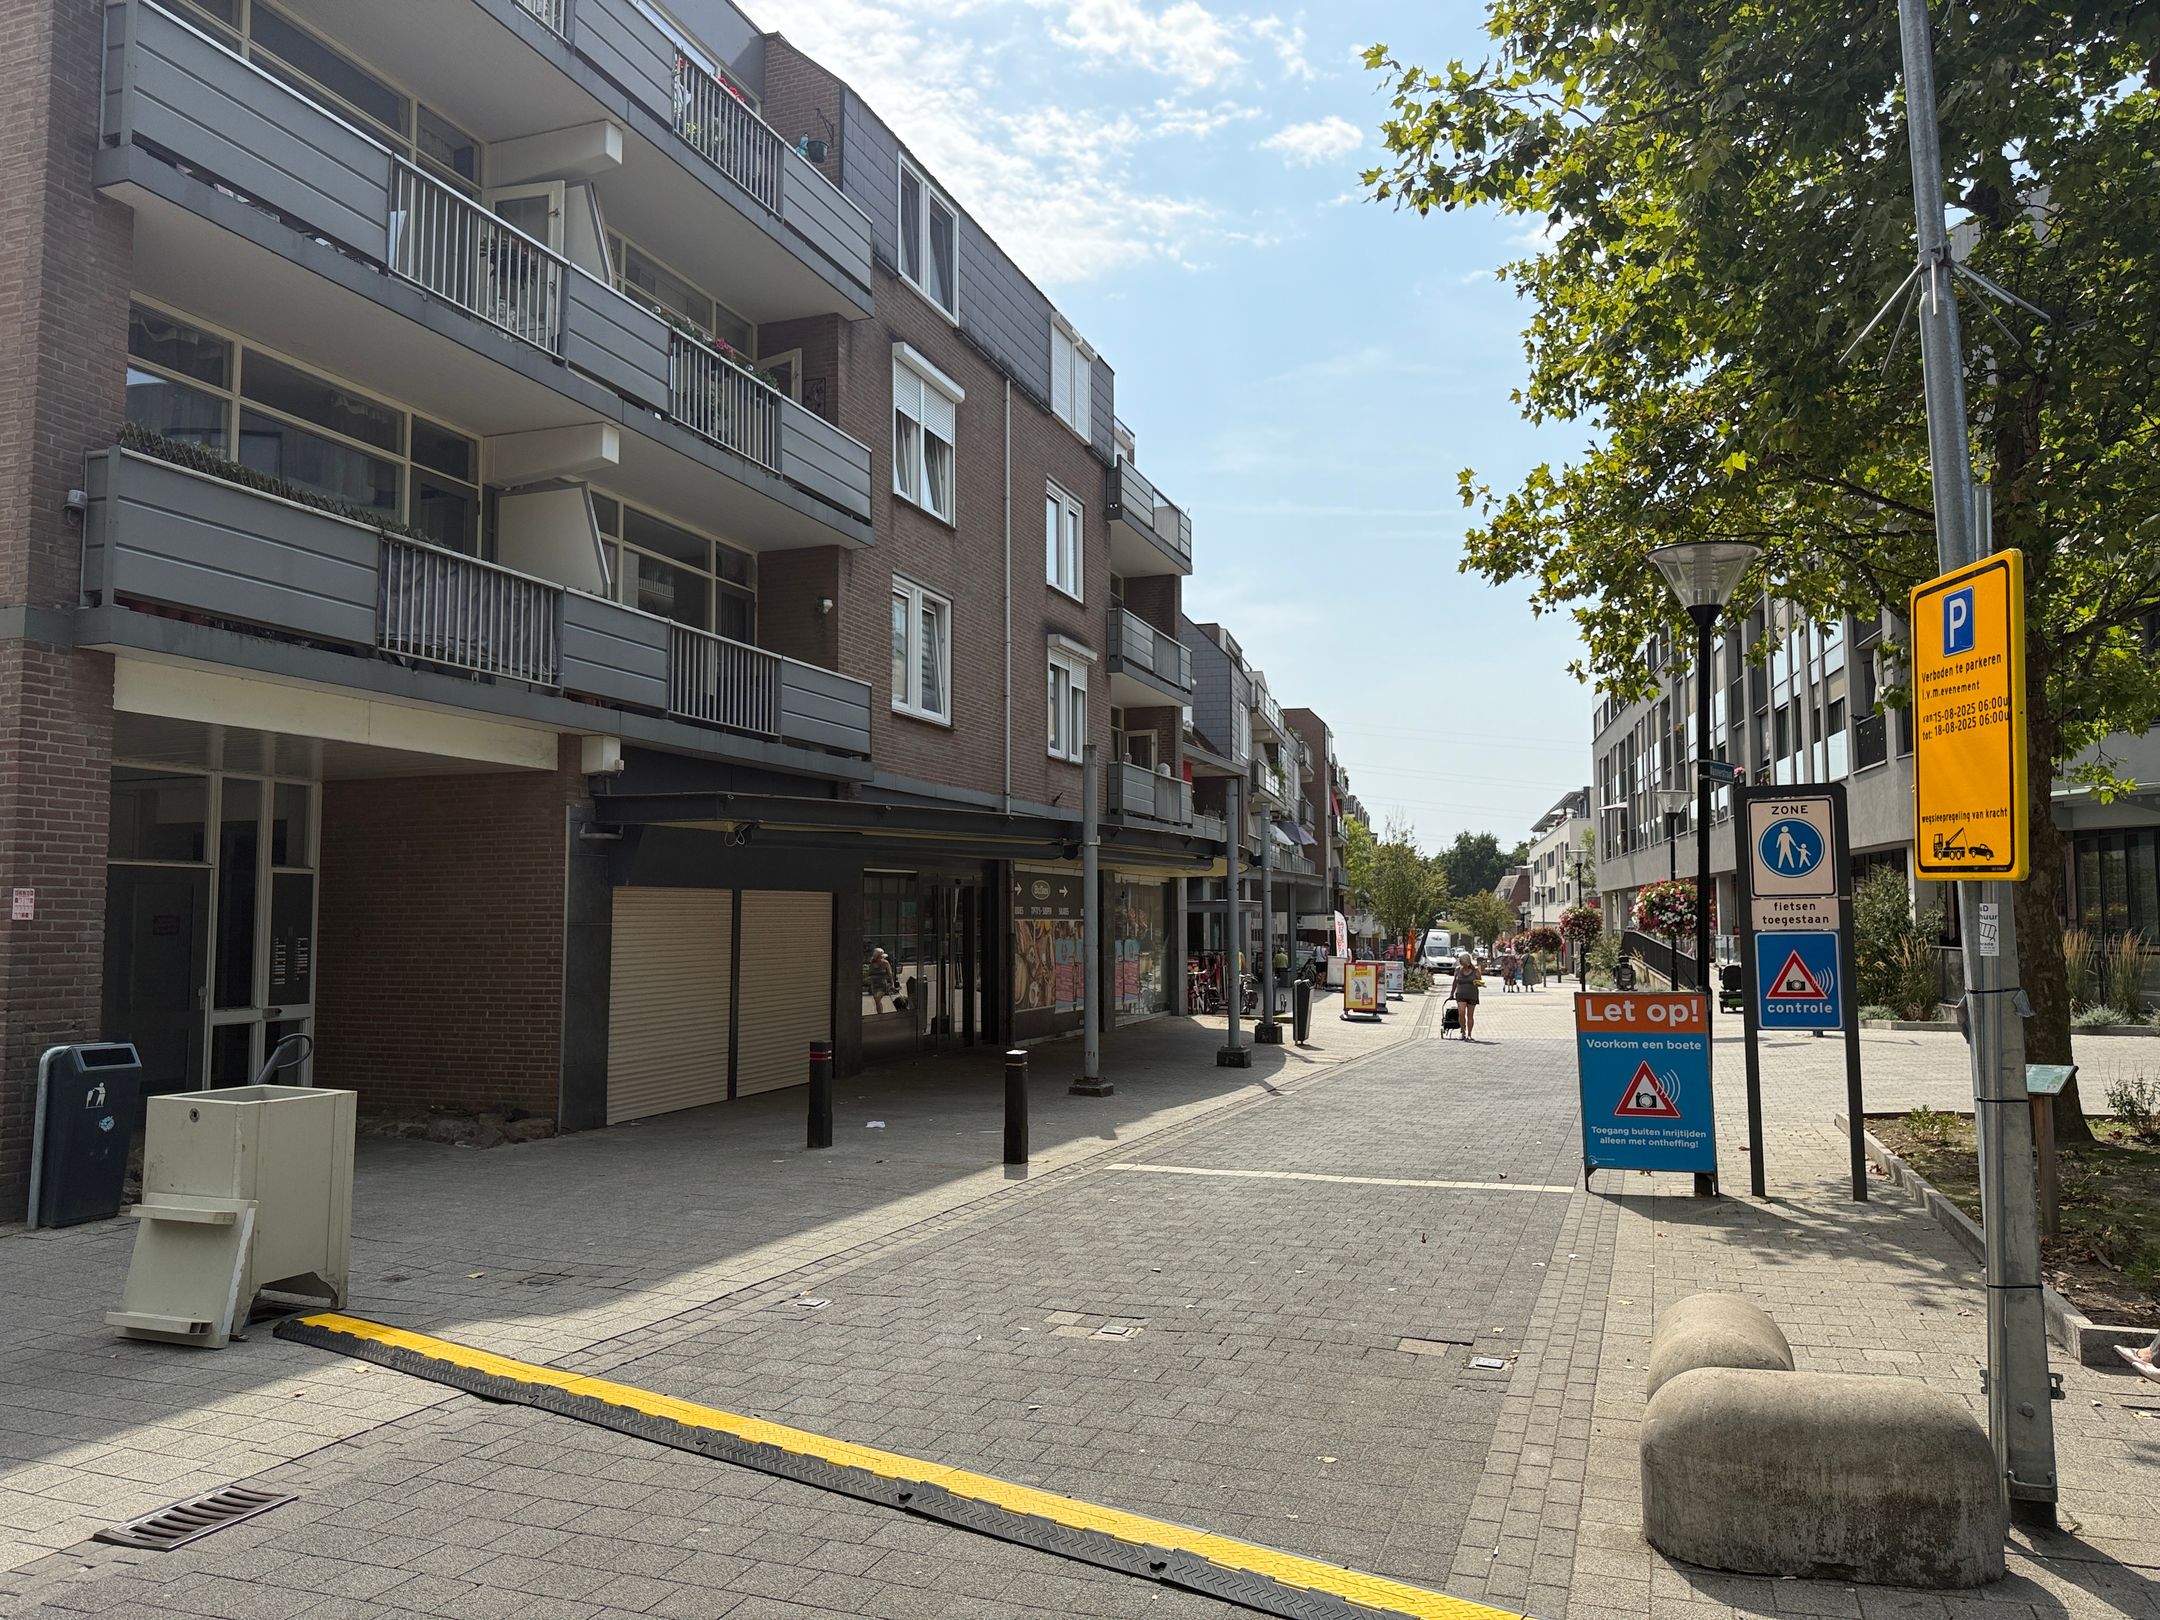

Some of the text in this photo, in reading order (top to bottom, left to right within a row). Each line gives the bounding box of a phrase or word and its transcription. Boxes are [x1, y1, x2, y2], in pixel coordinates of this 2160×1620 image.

[1949, 597, 1967, 648] P
[1922, 654, 2001, 683] Verboden te parkeren
[1978, 696, 2008, 712] 06:00u
[1923, 711, 2009, 740] tot: 18-08-2025 06:00u
[1771, 804, 1808, 815] ZONE
[1922, 808, 2007, 825] wegsleepregeling van kracht
[1773, 902, 1816, 912] fietsen
[1762, 914, 1830, 926] toegestaan
[1586, 1000, 1699, 1027] Let op!
[1767, 1002, 1833, 1014] controle
[1586, 1039, 1702, 1051] Voorkom een boete
[1591, 1126, 1706, 1138] Toegang buiten inrijtijden
[1649, 1139, 1698, 1149] ontheffing!
